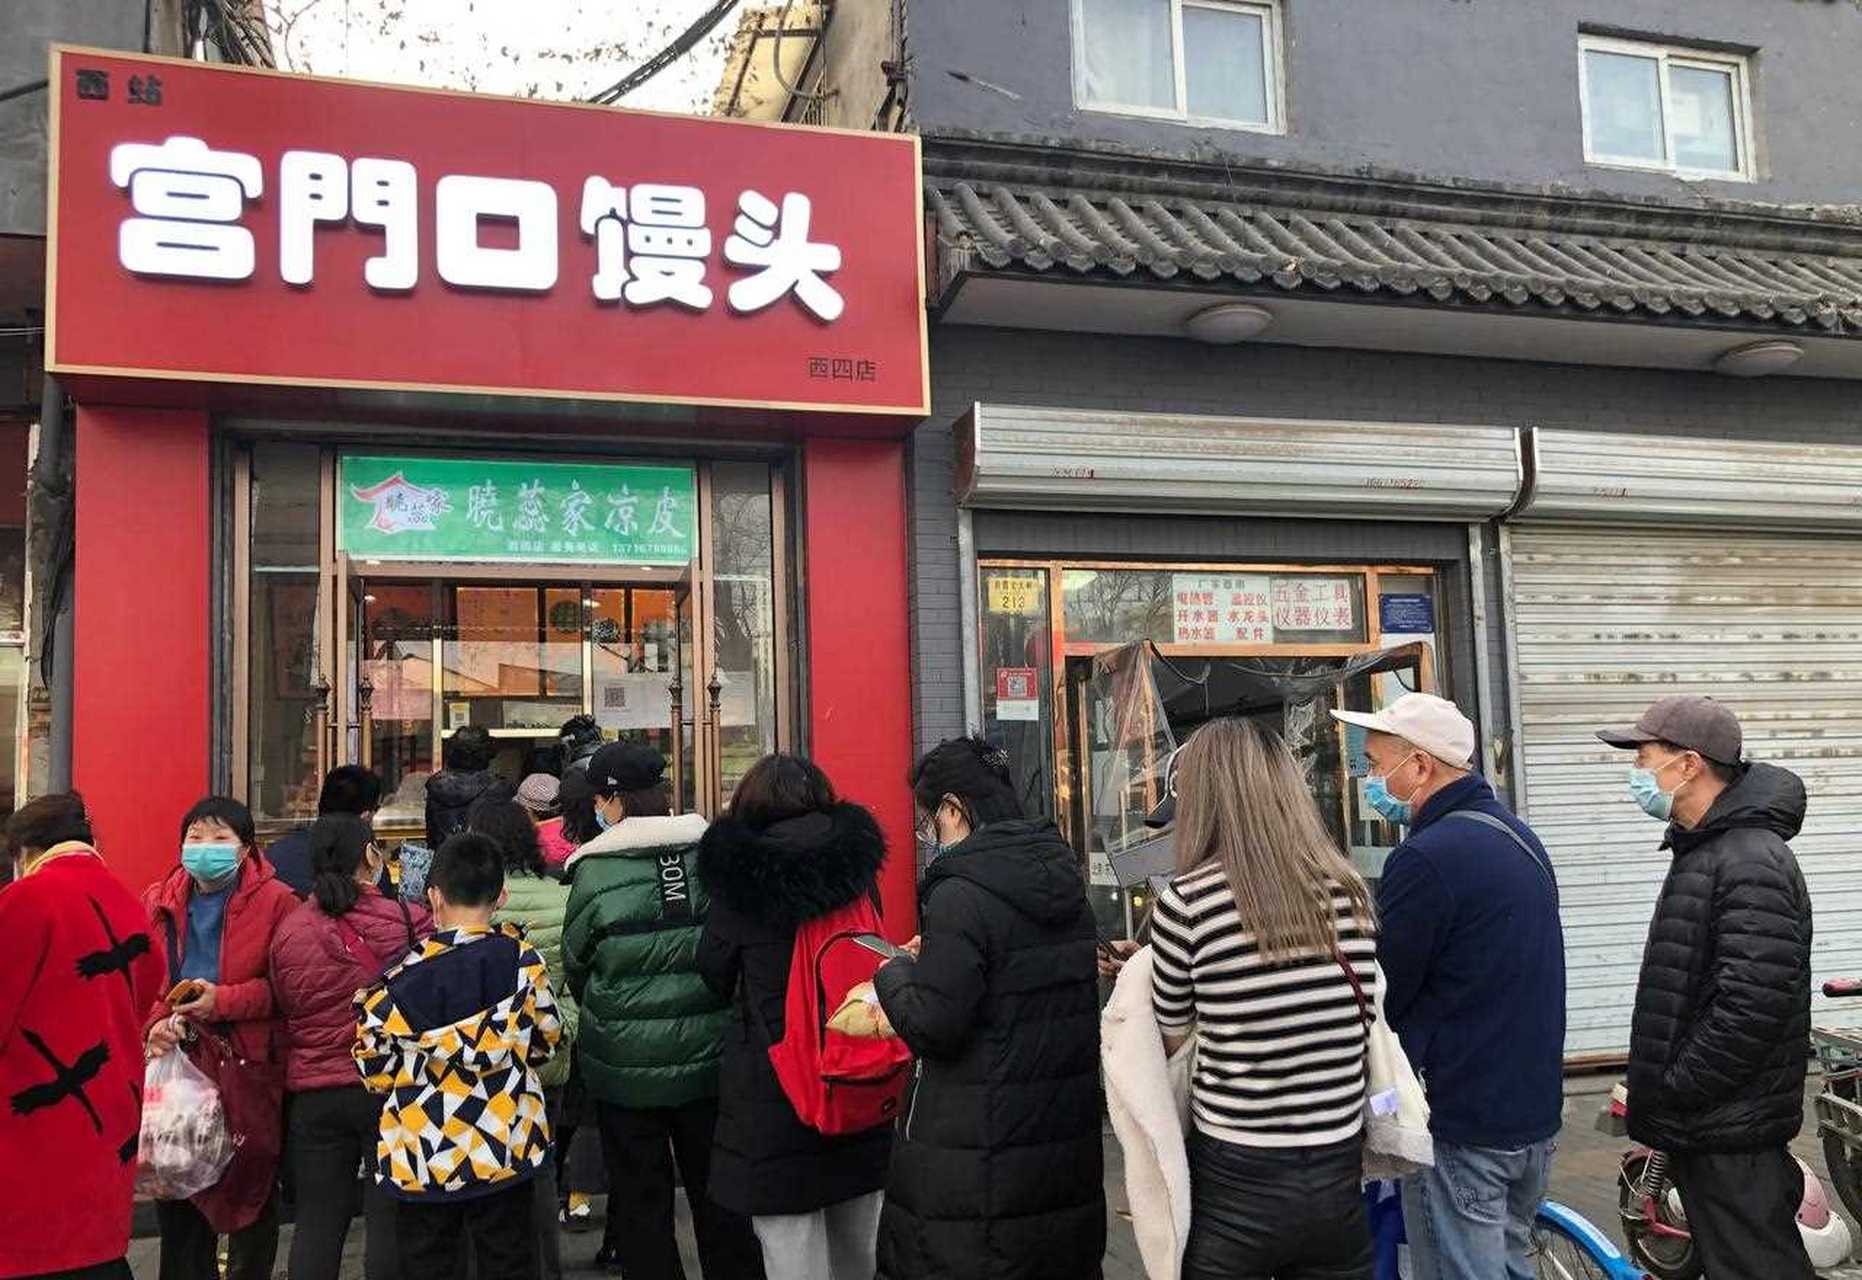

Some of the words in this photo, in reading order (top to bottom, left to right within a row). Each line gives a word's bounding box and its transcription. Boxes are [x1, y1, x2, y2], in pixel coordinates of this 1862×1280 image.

[808, 357, 877, 382] 西四店
[1274, 582, 1349, 605] 五金工具
[1275, 608, 1350, 626] 仪器仪表
[1236, 626, 1265, 641] 配件
